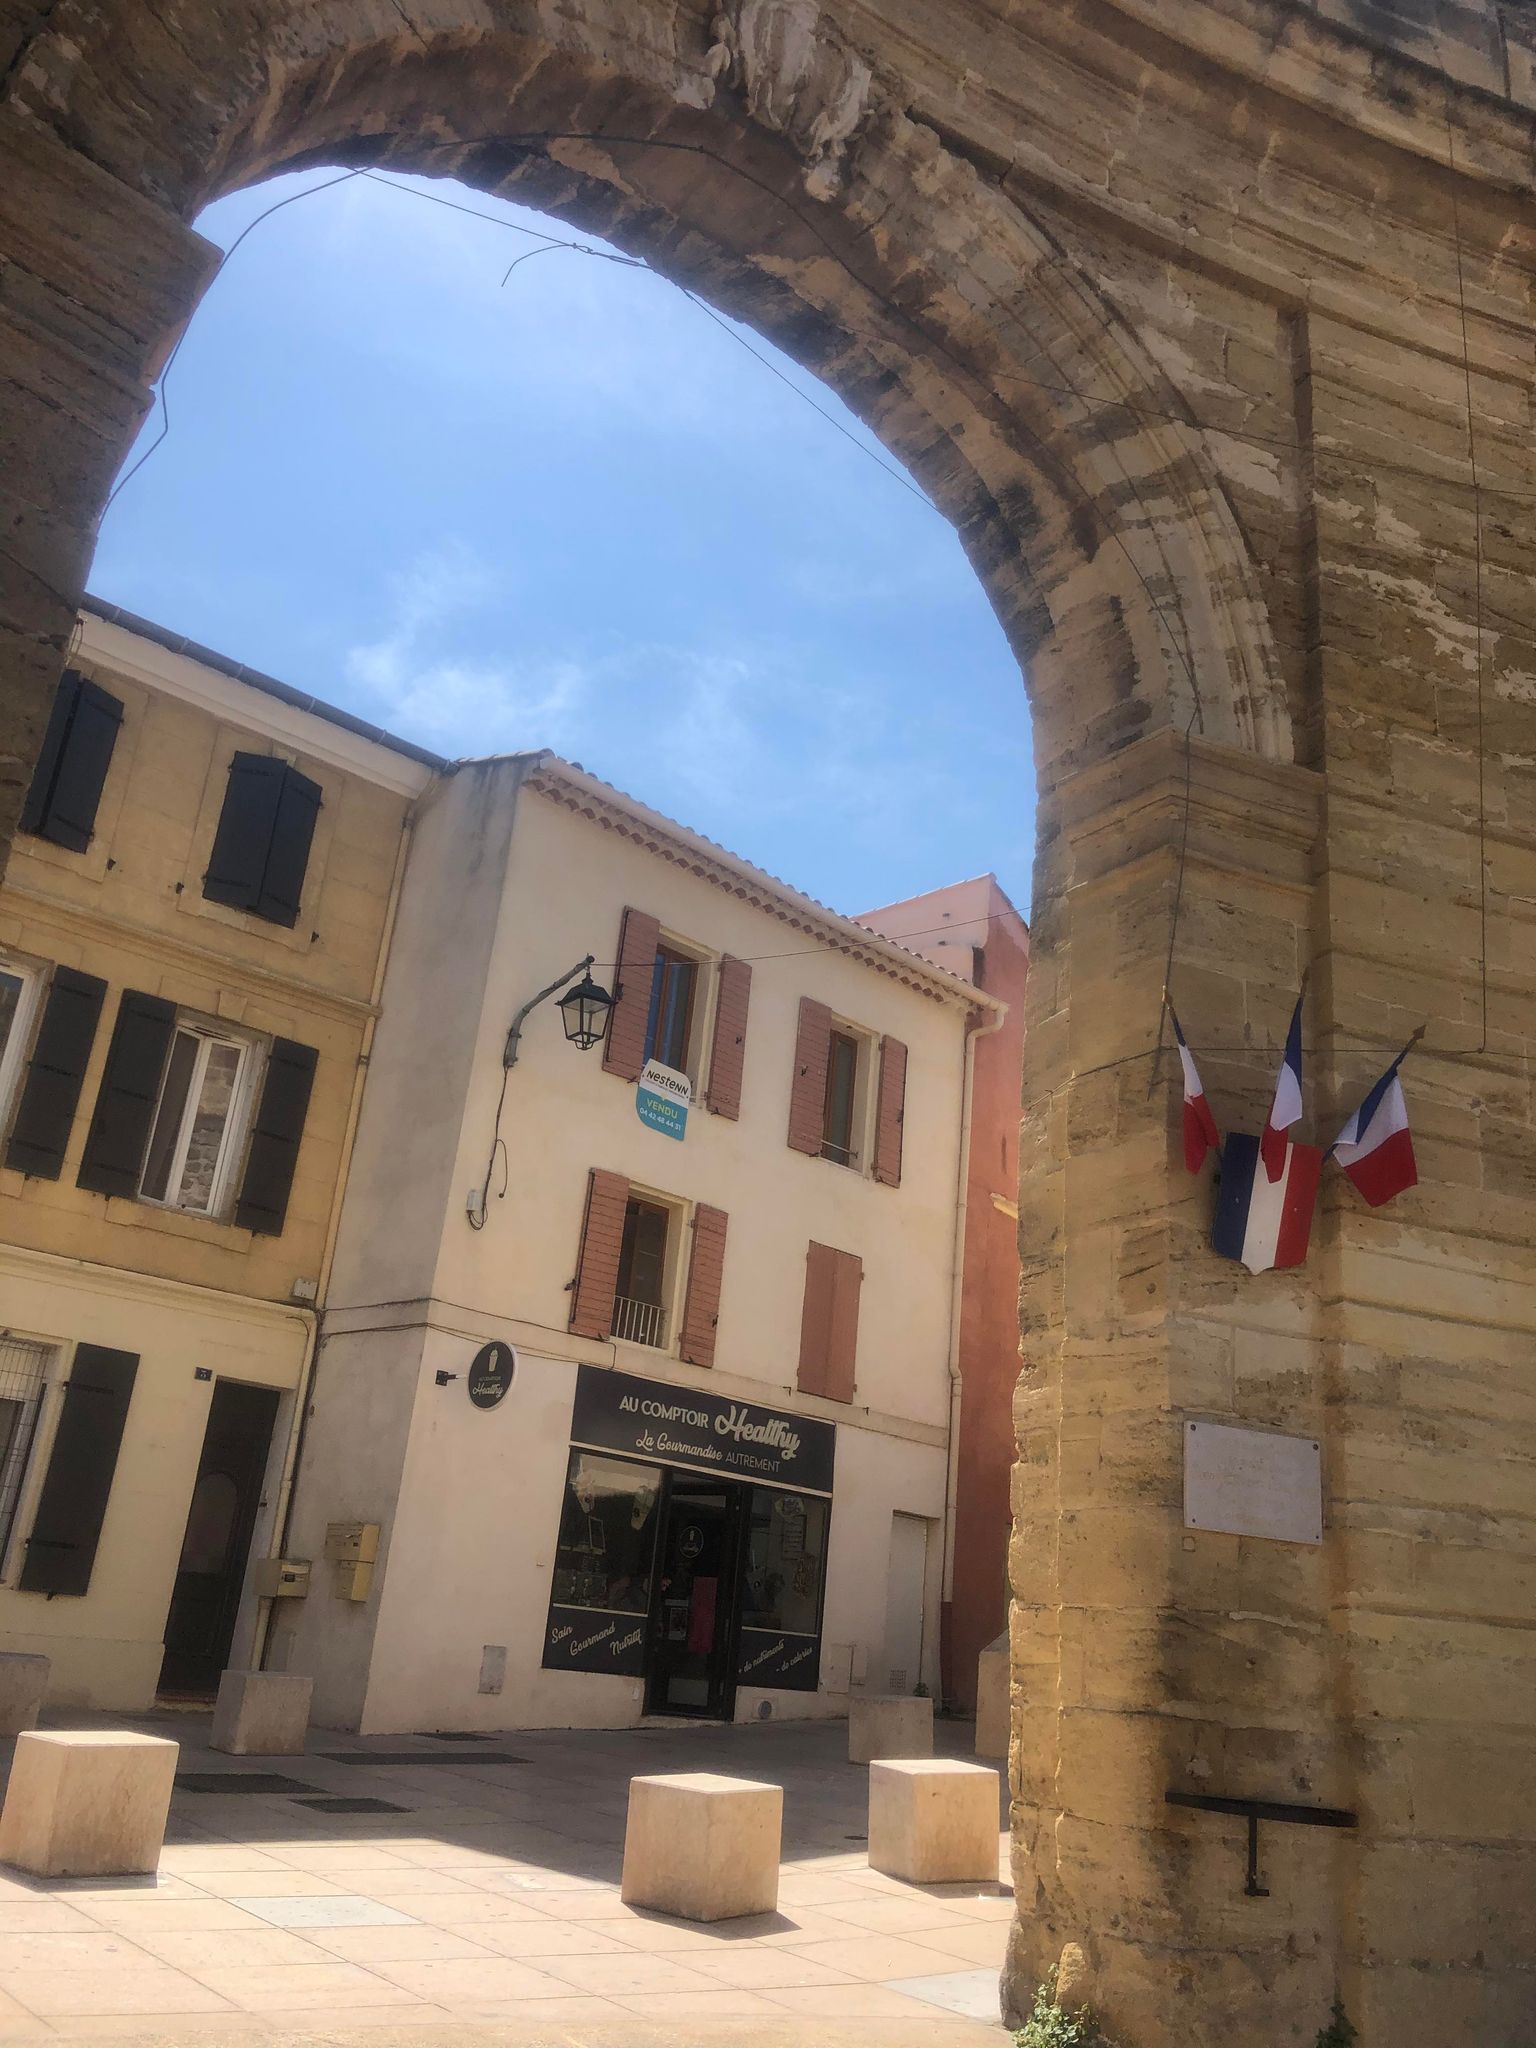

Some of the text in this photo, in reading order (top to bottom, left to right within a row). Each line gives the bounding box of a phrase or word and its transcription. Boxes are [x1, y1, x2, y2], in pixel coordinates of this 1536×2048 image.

[640, 1107, 648, 1117] 04
[648, 1112, 657, 1121] 42
[665, 1120, 674, 1128] 44
[647, 1098, 678, 1119] VENDU
[619, 1395, 800, 1460] AU COMPTOIR Healthy
[635, 1429, 780, 1472] La Gourmandise AUTREMENT
[551, 1625, 573, 1644] Sain
[569, 1620, 616, 1656] Gourmand
